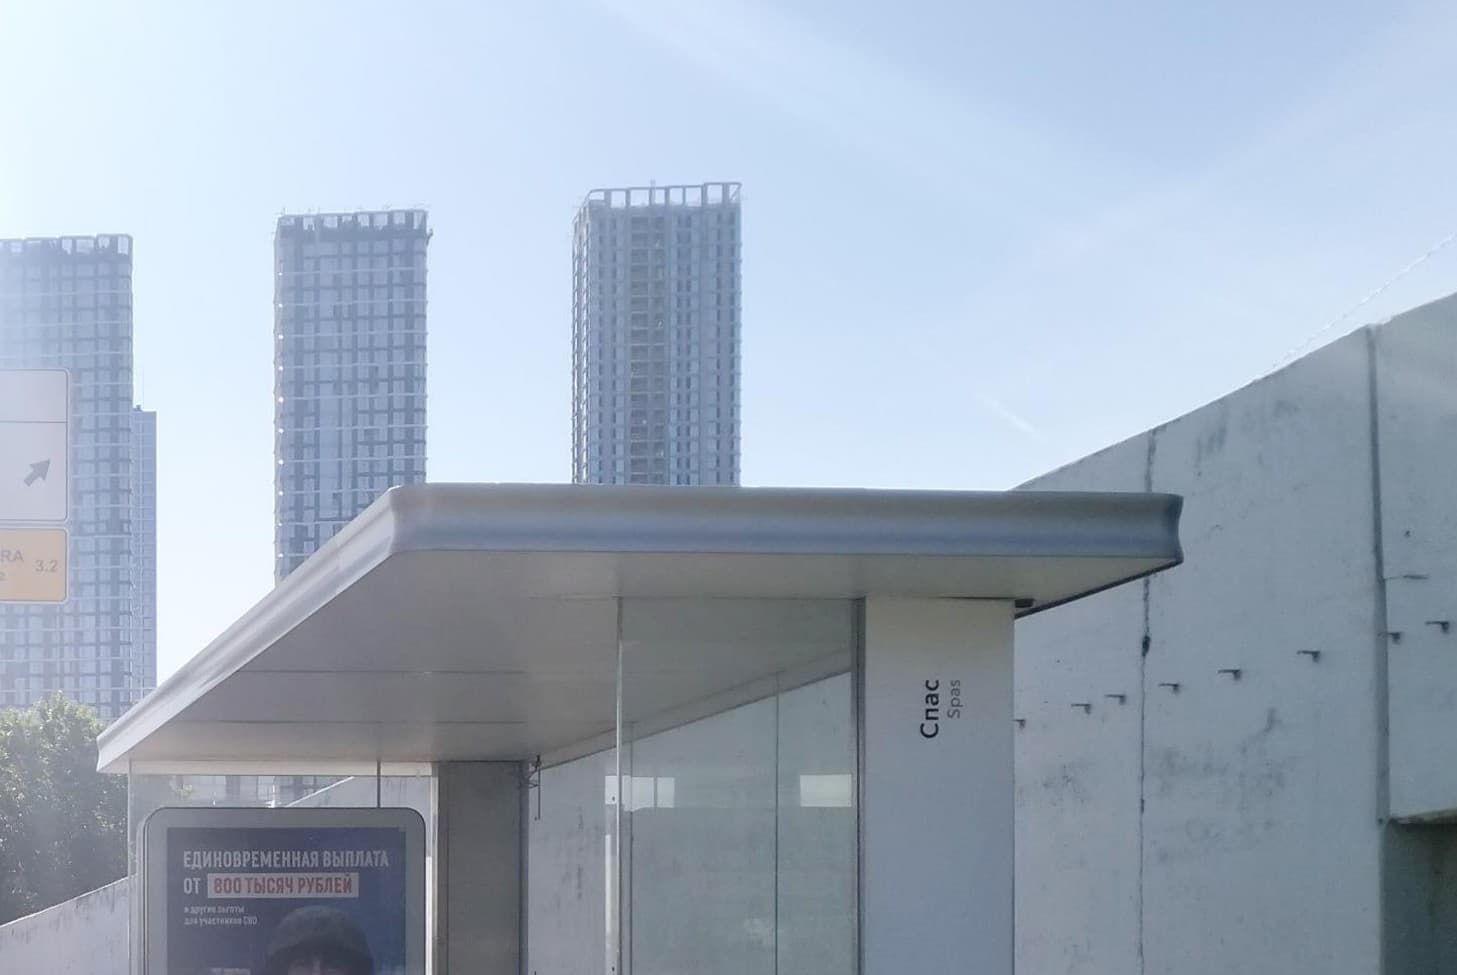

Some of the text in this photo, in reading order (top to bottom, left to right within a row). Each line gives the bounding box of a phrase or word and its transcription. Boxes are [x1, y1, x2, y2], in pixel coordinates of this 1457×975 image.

[35, 559, 59, 573] 3.2
[920, 679, 940, 739] Спас
[947, 679, 964, 719] Spas
[183, 850, 390, 869] ЕДИНОВРЕМЕННАЯ ВЫПЛАТА
[183, 874, 353, 895] ОТ 800 ТЫСЯЧ РУБЛЕЙ
